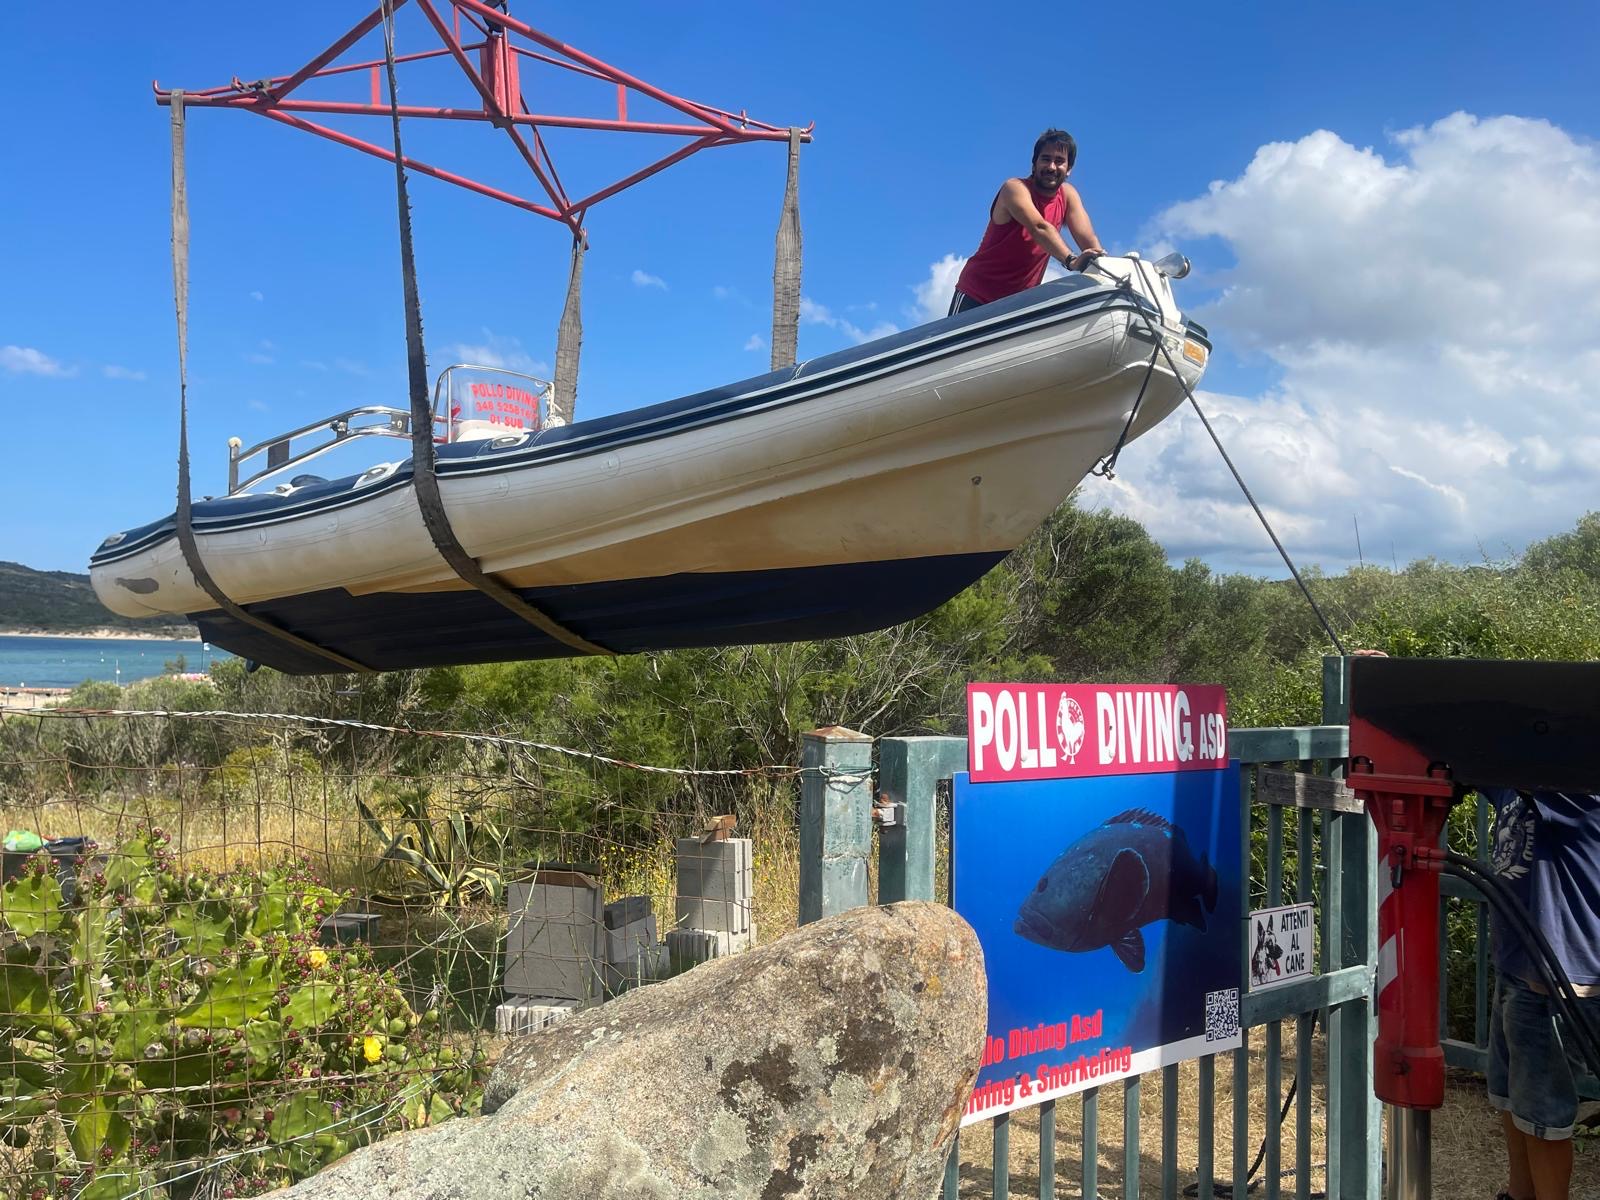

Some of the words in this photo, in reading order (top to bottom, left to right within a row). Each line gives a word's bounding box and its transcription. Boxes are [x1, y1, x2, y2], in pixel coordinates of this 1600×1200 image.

[471, 383, 504, 399] POLLO
[505, 385, 539, 410] DIVING
[504, 416, 524, 429] SUB
[1097, 690, 1193, 765] DIVING
[1200, 712, 1225, 760] ASD
[1281, 910, 1309, 933] ATTENTI
[1291, 933, 1300, 952] AL
[1286, 952, 1305, 975] CANE
[1008, 1022, 1067, 1060] Diving
[1070, 1009, 1104, 1044] Asd
[962, 1078, 1016, 1117] iving
[1019, 1072, 1033, 1099] &
[1037, 1046, 1132, 1093] Snorkeling
